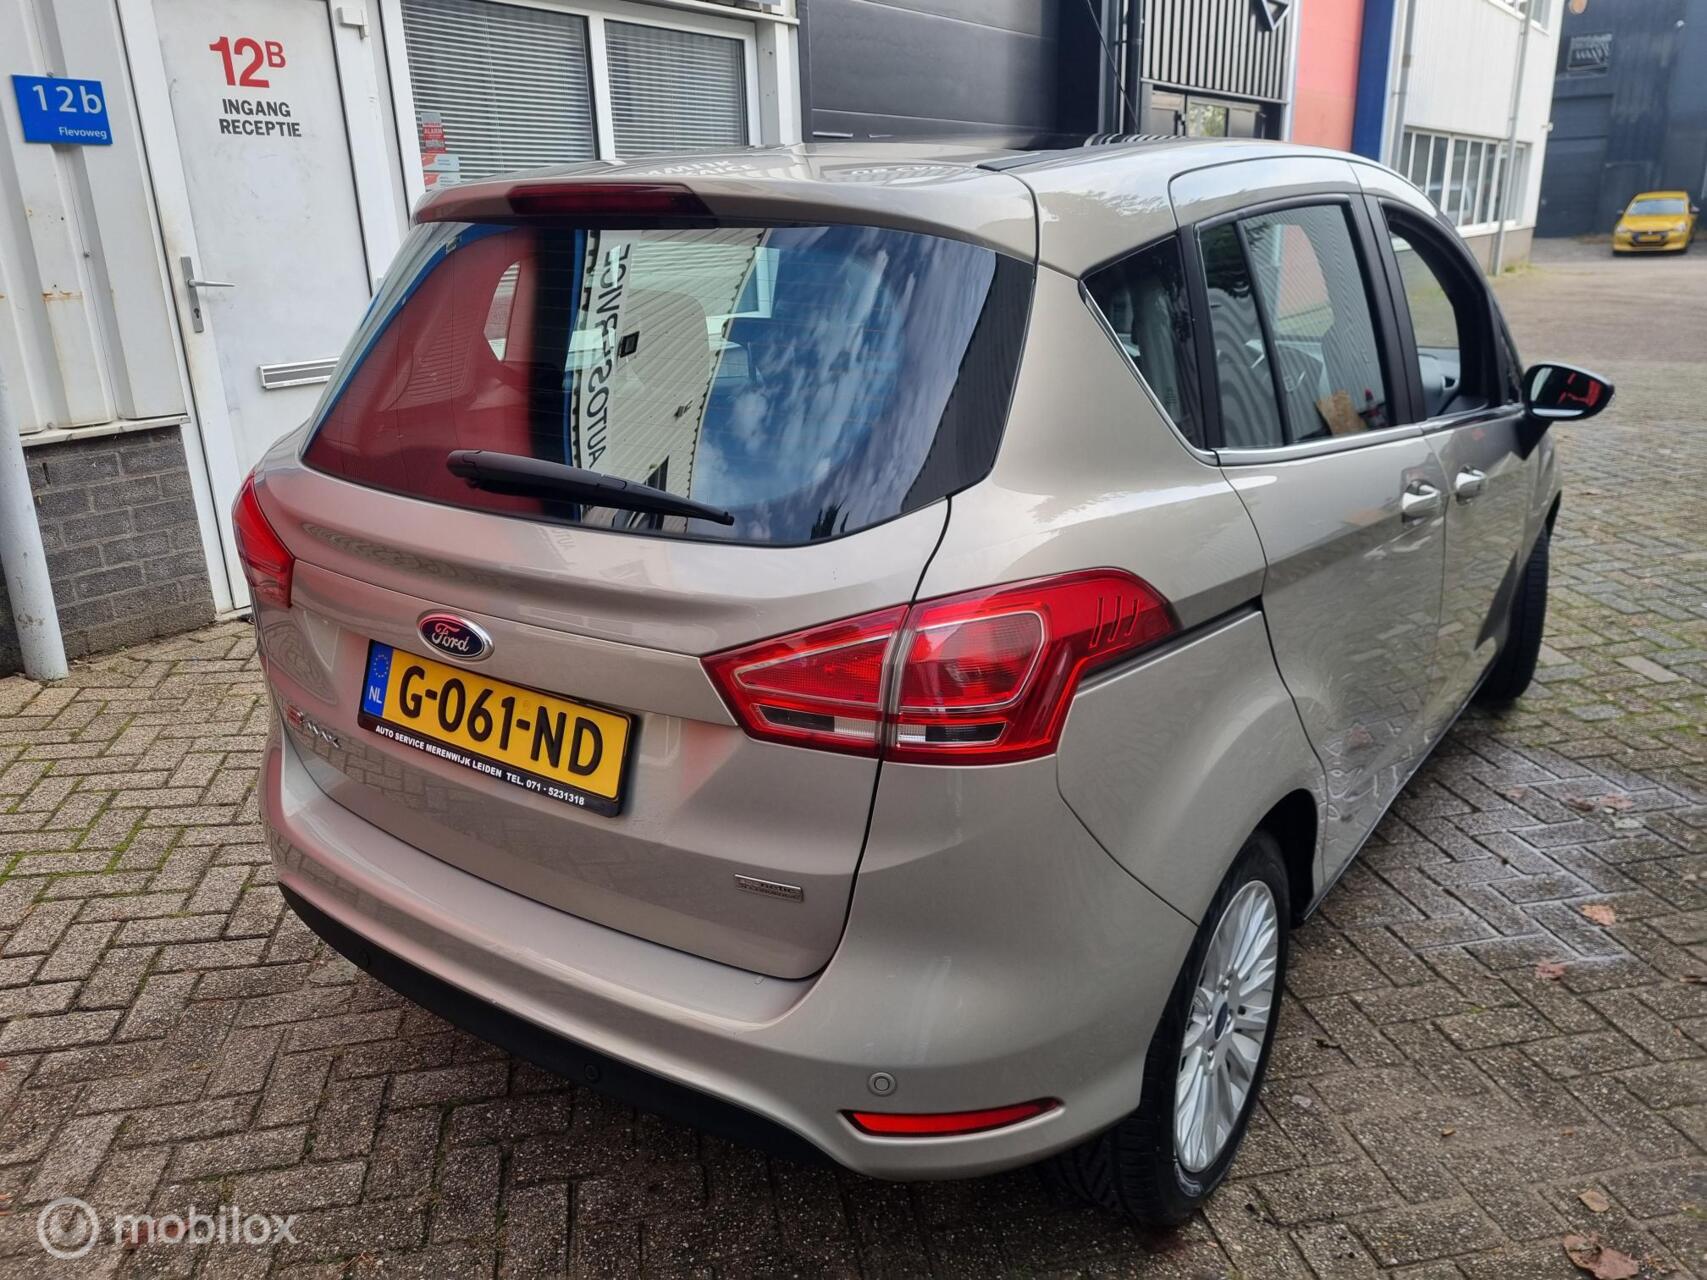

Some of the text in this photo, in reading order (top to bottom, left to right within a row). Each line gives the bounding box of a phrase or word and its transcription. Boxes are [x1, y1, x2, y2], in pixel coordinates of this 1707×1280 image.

[208, 36, 286, 88] 12B
[32, 85, 102, 114] 12b
[222, 98, 291, 117] INGANG
[59, 126, 107, 140] Flevoweg
[219, 118, 302, 137] RECEPTIE
[431, 622, 470, 652] Ford
[368, 685, 383, 704] NL
[399, 665, 603, 776] G-061-ND
[375, 725, 394, 738] AUTO
[395, 732, 425, 750] SERVICE
[425, 743, 471, 767] MERENWIJK
[472, 760, 502, 778] LEIDEN
[506, 772, 524, 786] TEL.
[526, 779, 541, 792] 071
[548, 786, 585, 806] 5231318
